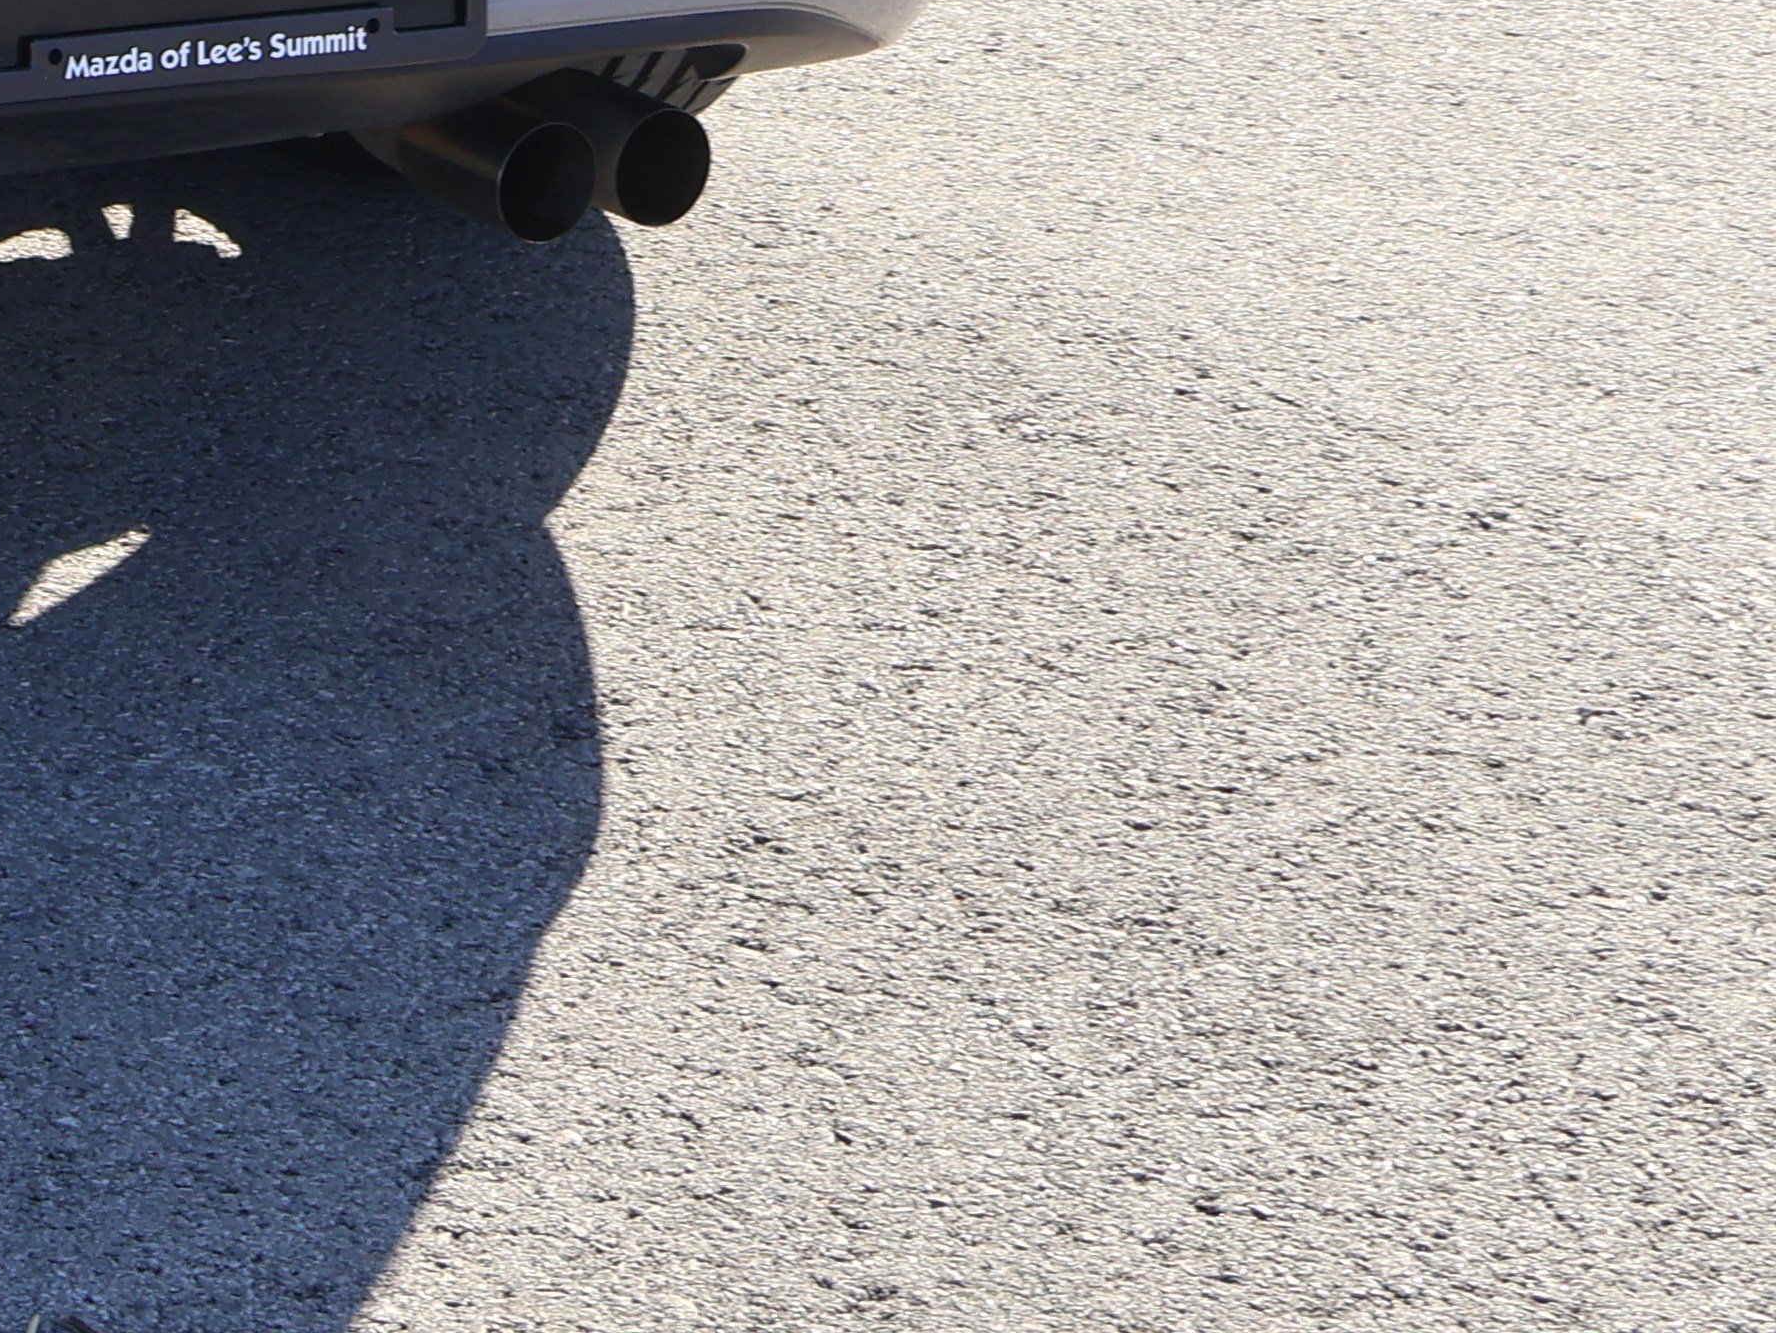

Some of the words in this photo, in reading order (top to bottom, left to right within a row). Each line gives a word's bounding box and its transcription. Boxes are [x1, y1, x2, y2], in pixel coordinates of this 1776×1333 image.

[63, 46, 153, 81] Mazda
[159, 39, 193, 70] of
[196, 33, 263, 67] Lee's
[268, 25, 368, 61] Summit
